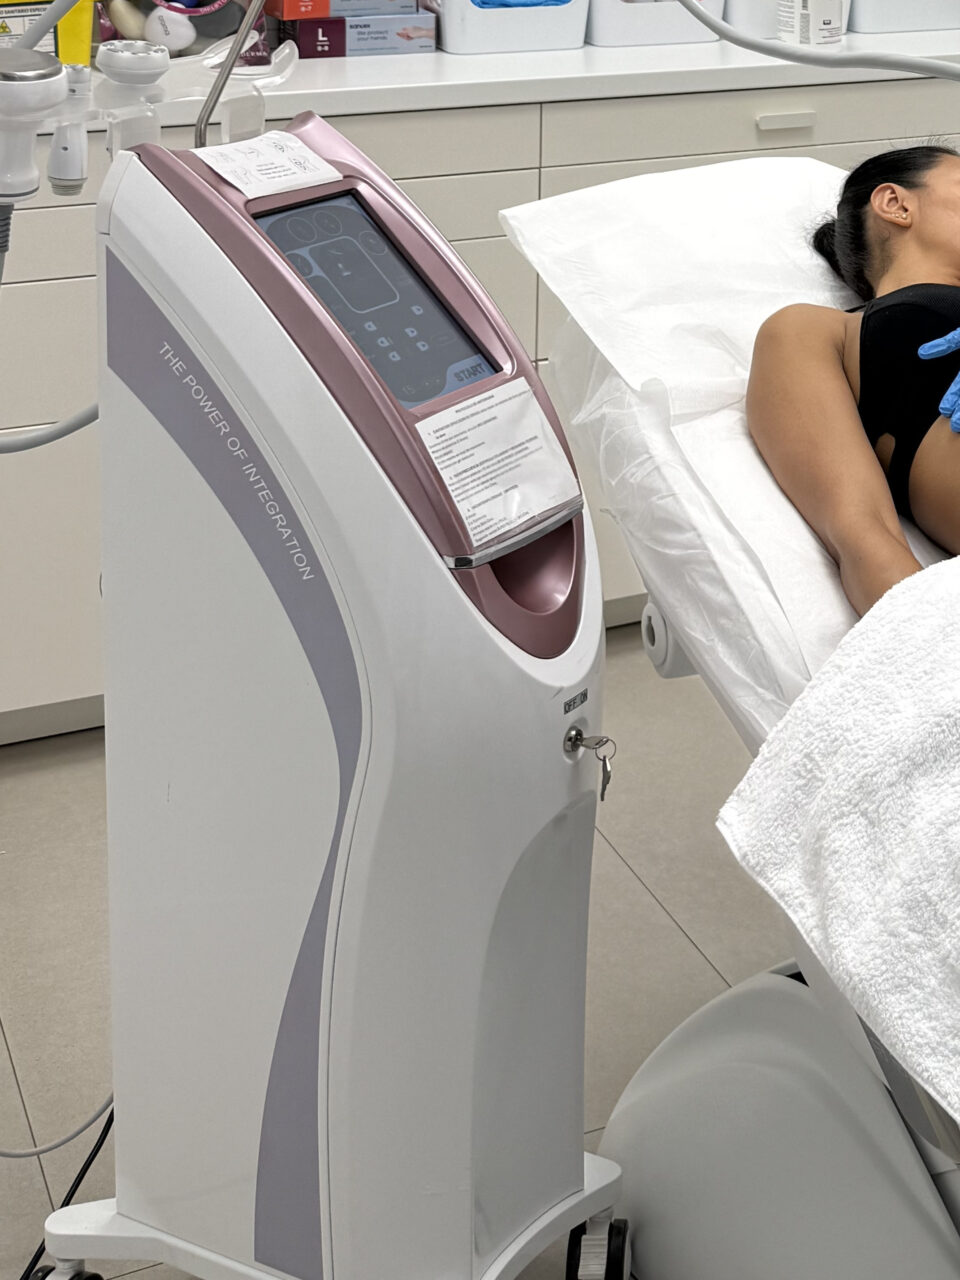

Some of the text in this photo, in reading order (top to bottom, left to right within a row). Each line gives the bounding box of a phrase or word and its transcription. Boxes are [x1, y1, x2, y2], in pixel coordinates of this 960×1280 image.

[318, 28, 328, 41] L
[454, 363, 487, 382] START
[160, 341, 315, 580] THE POWER OF INTEGRATION
[564, 698, 577, 713] OFF
